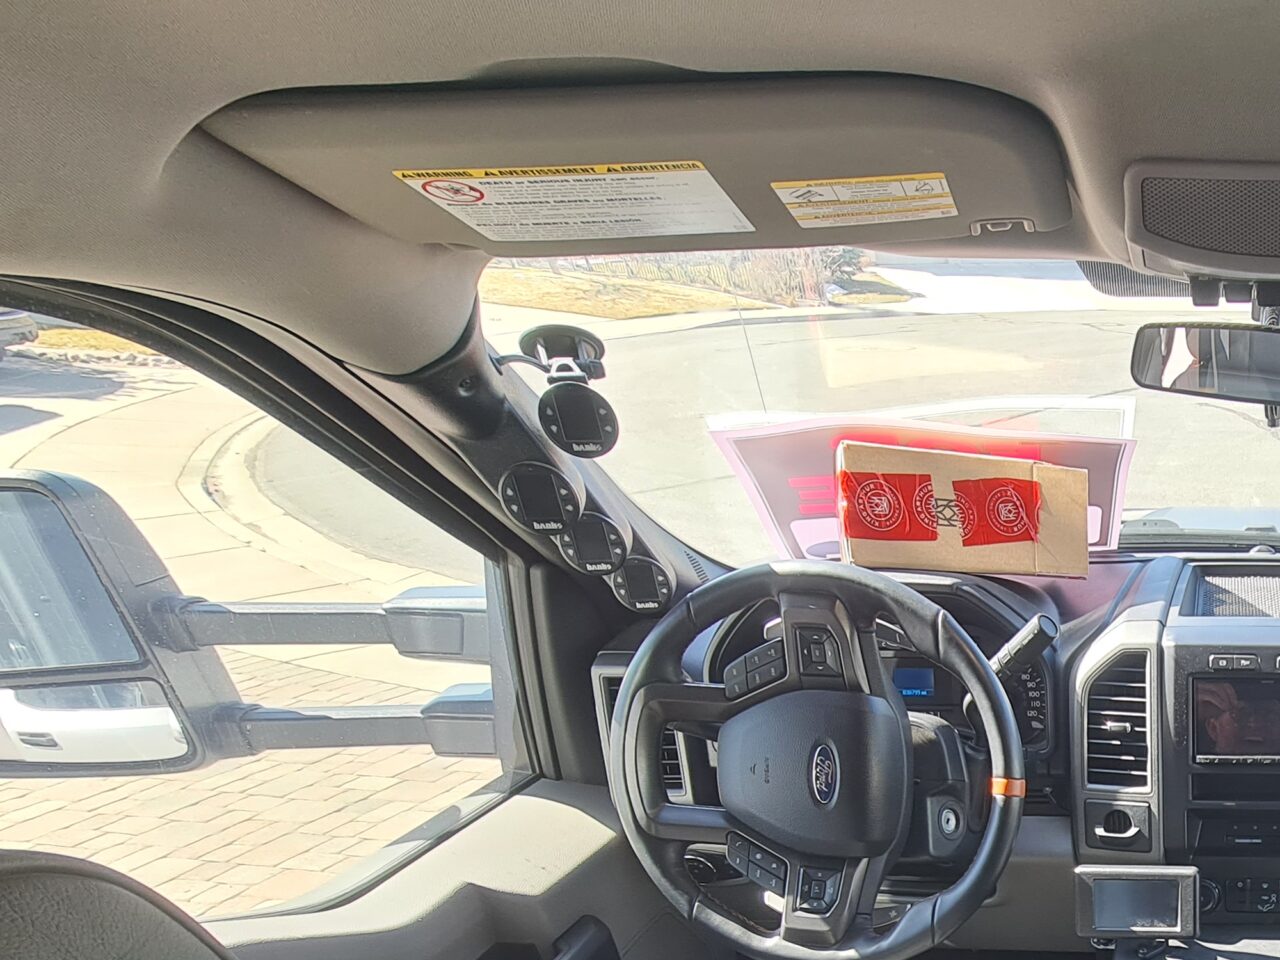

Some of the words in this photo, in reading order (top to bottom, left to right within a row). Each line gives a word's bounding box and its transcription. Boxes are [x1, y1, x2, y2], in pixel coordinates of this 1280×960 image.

[497, 167, 597, 178] AVERTISSEMENT
[620, 162, 701, 173] ADVERTENCIA
[857, 483, 875, 511] ARTHUR
[915, 484, 933, 512] ARTHUR
[862, 511, 880, 527] KING
[532, 520, 563, 531] banks
[586, 561, 612, 572] banks
[635, 600, 659, 610] banks
[1026, 681, 1037, 689] 90
[1028, 690, 1041, 699] 100
[1030, 700, 1042, 708] 110
[816, 755, 833, 793] Ford
